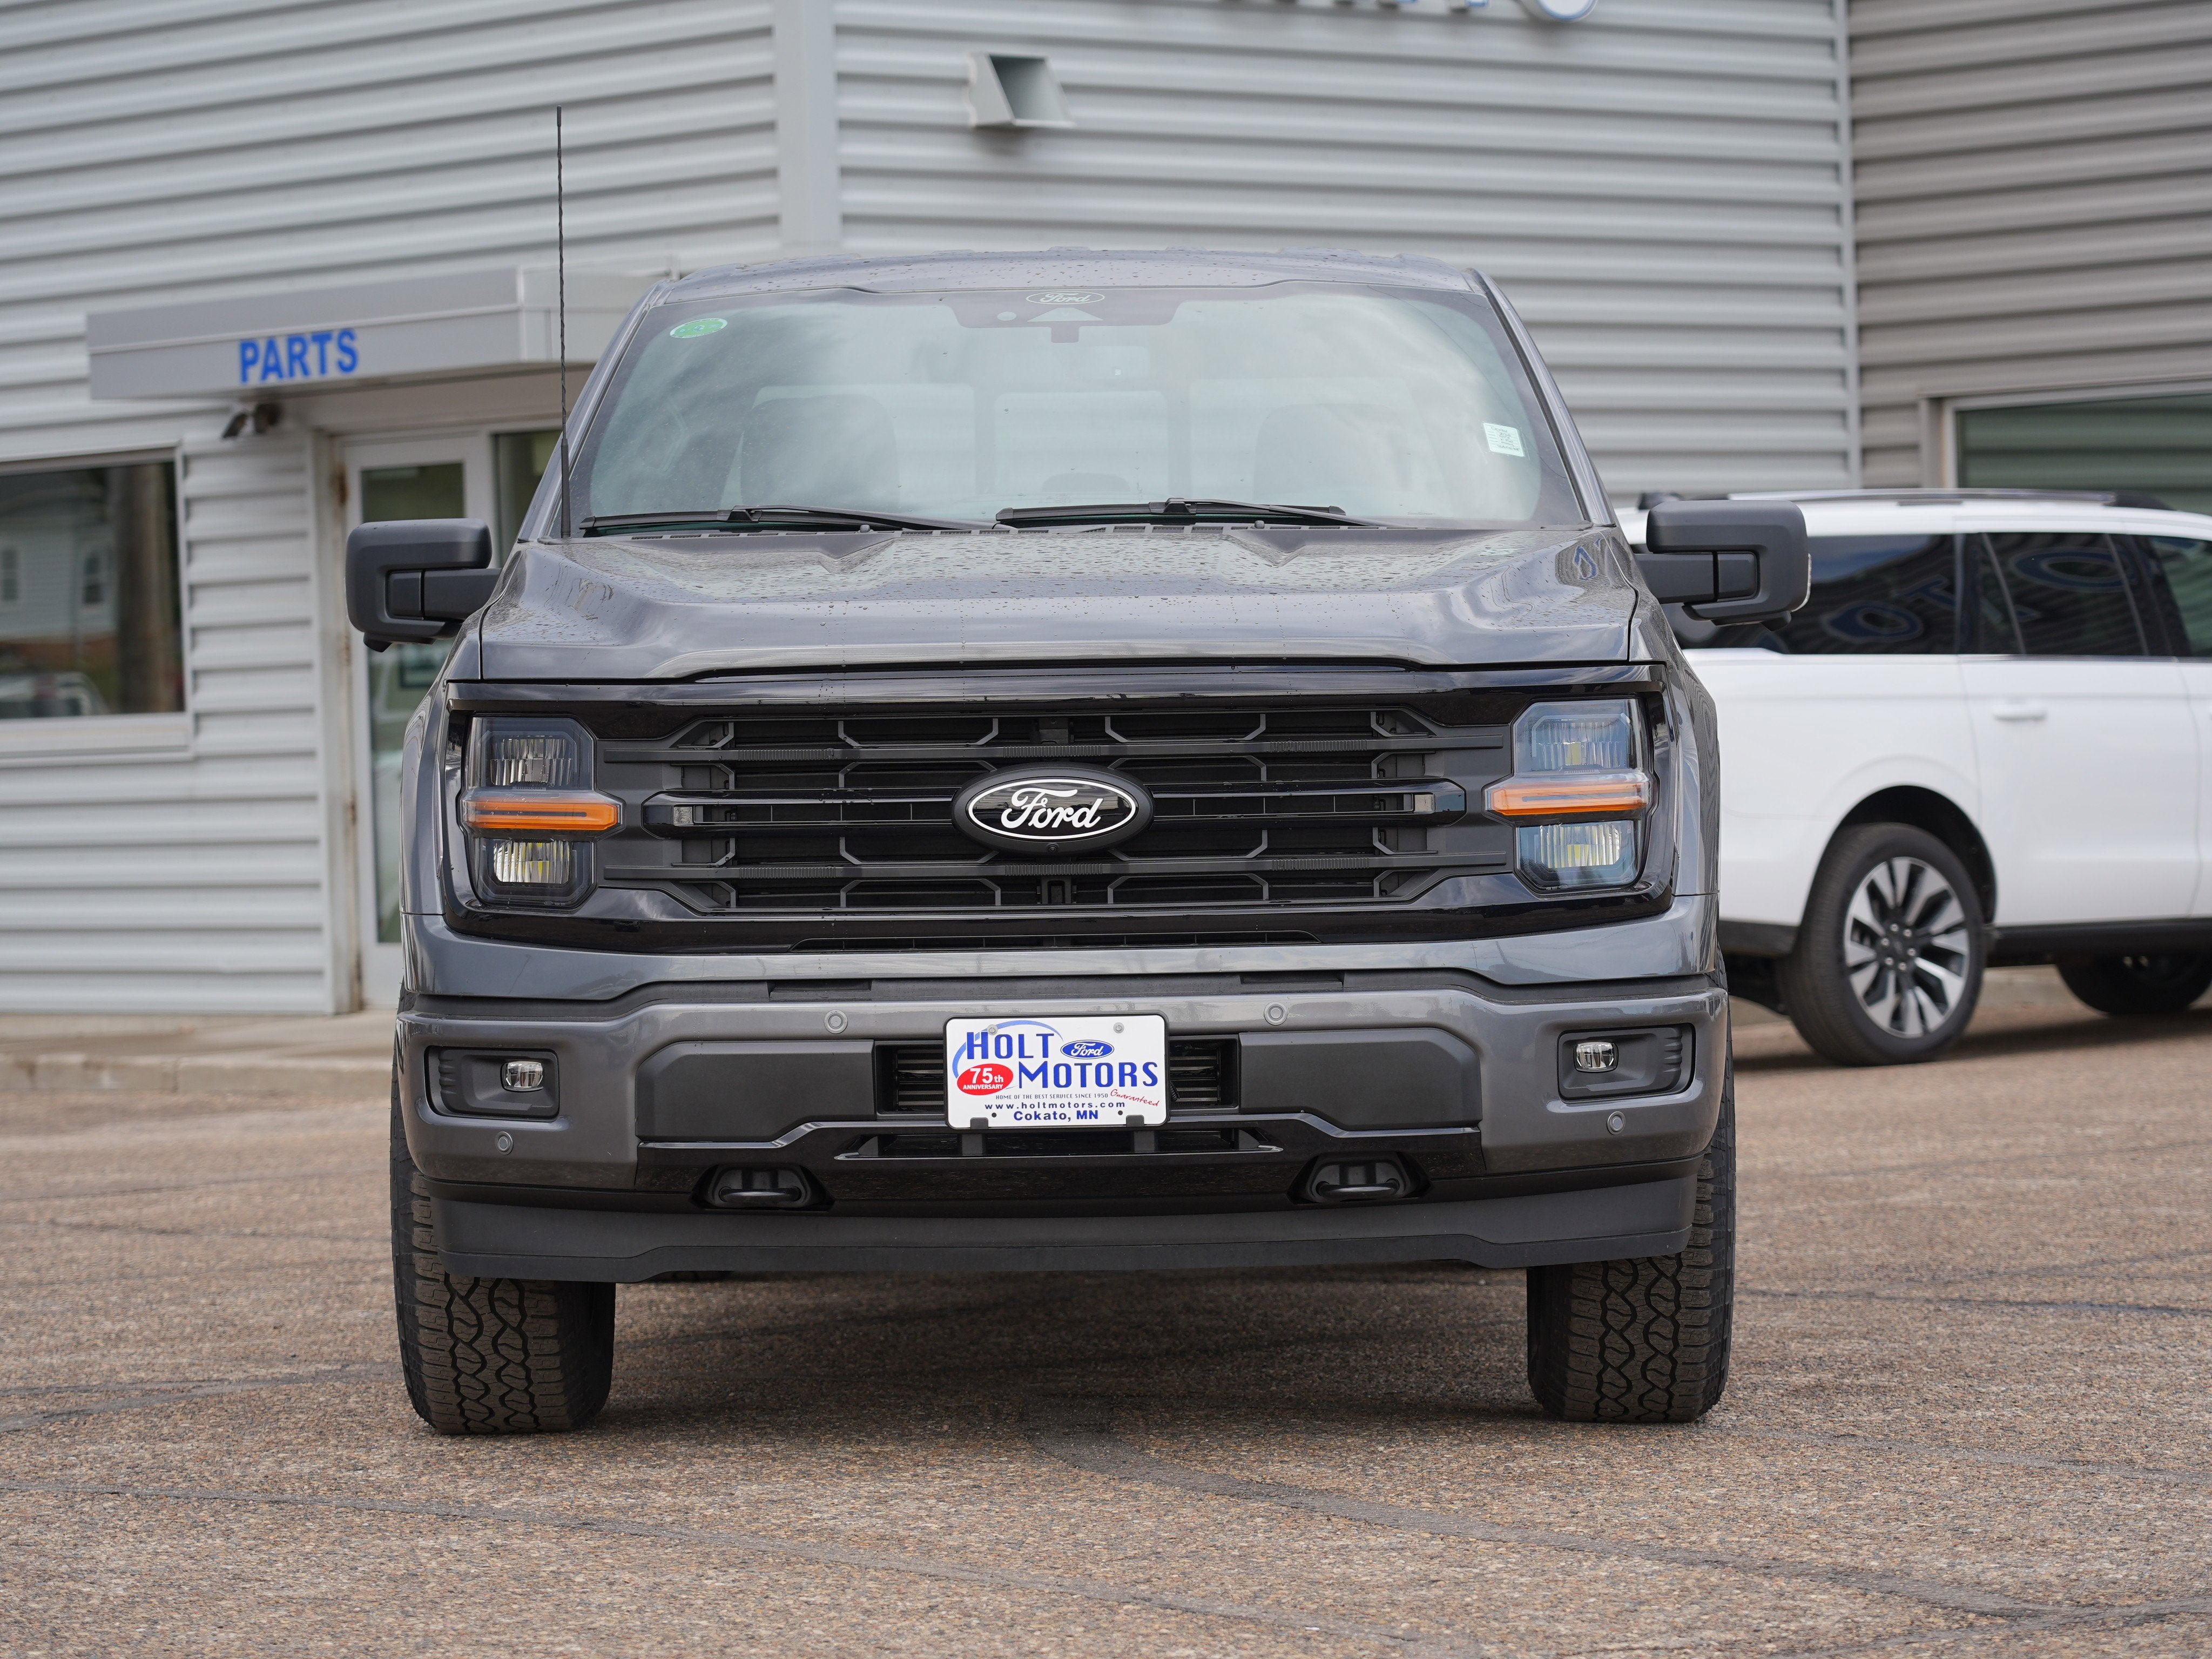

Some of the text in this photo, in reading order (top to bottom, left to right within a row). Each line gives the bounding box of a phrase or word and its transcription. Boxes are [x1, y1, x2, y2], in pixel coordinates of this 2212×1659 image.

[1040, 293, 1092, 302] Ford
[240, 328, 359, 383] PARTS
[1001, 787, 1103, 828] Ford
[967, 1031, 1054, 1059] HOLT
[1071, 1042, 1104, 1056] Ford
[970, 1068, 1004, 1084] 75th
[1019, 1061, 1158, 1088] MOTORS
[1110, 1089, 1160, 1107] Guaranteed
[1014, 1110, 1098, 1122] Cokato, MN
